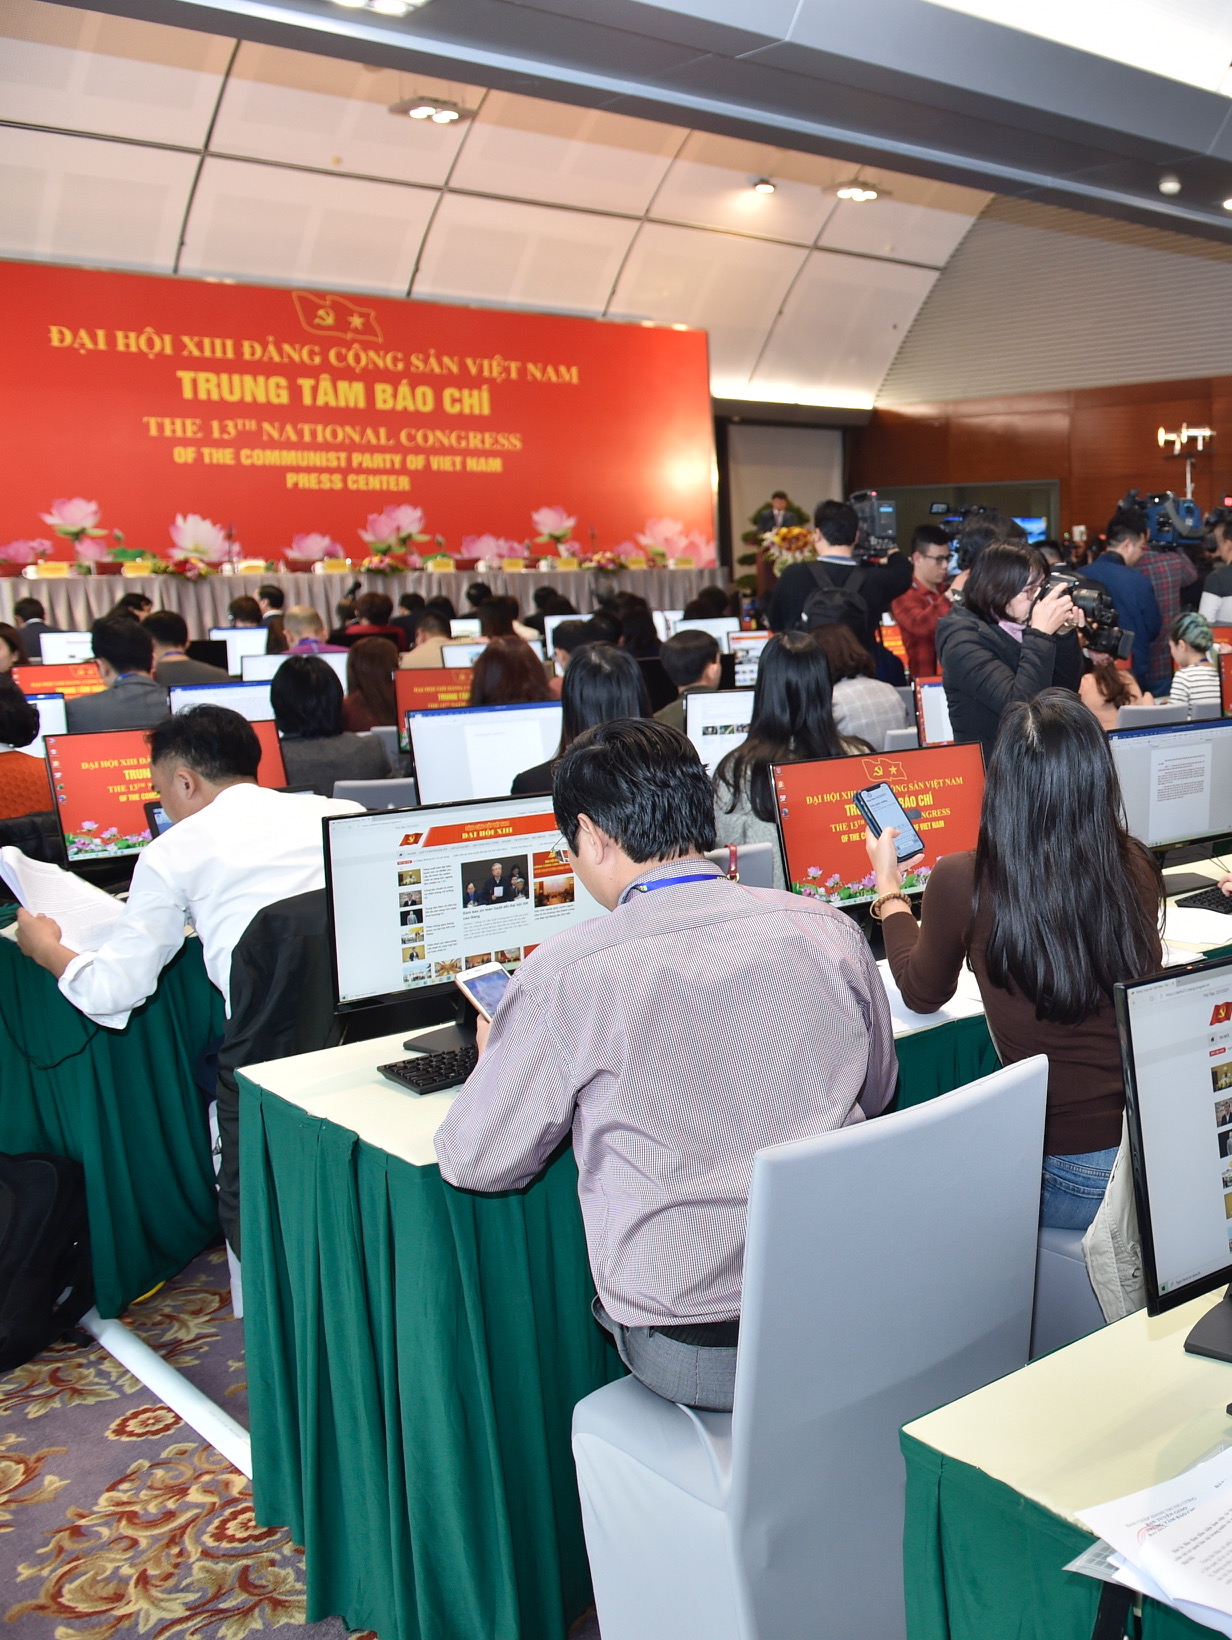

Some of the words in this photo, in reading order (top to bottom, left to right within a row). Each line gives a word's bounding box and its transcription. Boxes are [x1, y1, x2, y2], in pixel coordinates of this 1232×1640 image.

[49, 325, 108, 354] ĐẠI
[115, 326, 173, 360] HỘI
[180, 335, 235, 360] XIII
[241, 335, 321, 366] ĐẢNG
[328, 343, 404, 374] CỘNG
[410, 348, 460, 376] SẢN
[465, 354, 521, 384] VIỆT
[526, 362, 579, 385] NAM
[176, 369, 290, 406] TRUNG
[297, 373, 366, 409] TÂM
[374, 378, 435, 414] BÁO
[442, 384, 492, 416] CHÍ
[143, 416, 203, 438] THE
[262, 421, 395, 446] NATIONAL
[400, 427, 524, 450] CONGRESS
[172, 446, 197, 464] OF
[200, 447, 235, 465] THE
[240, 448, 347, 468] COMMUNIST
[351, 452, 402, 470] PARTY
[406, 454, 426, 470] OF
[429, 454, 463, 472] VIET
[466, 456, 503, 473] NAM
[286, 472, 343, 490] PRESS
[346, 474, 411, 492] CENTER
[123, 768, 152, 780] TRUN
[945, 776, 964, 786] NAM
[918, 792, 934, 806] CHÍ
[830, 822, 848, 832] THE
[921, 808, 950, 819] NGRESS
[841, 834, 849, 843] OF
[850, 833, 860, 842] THE
